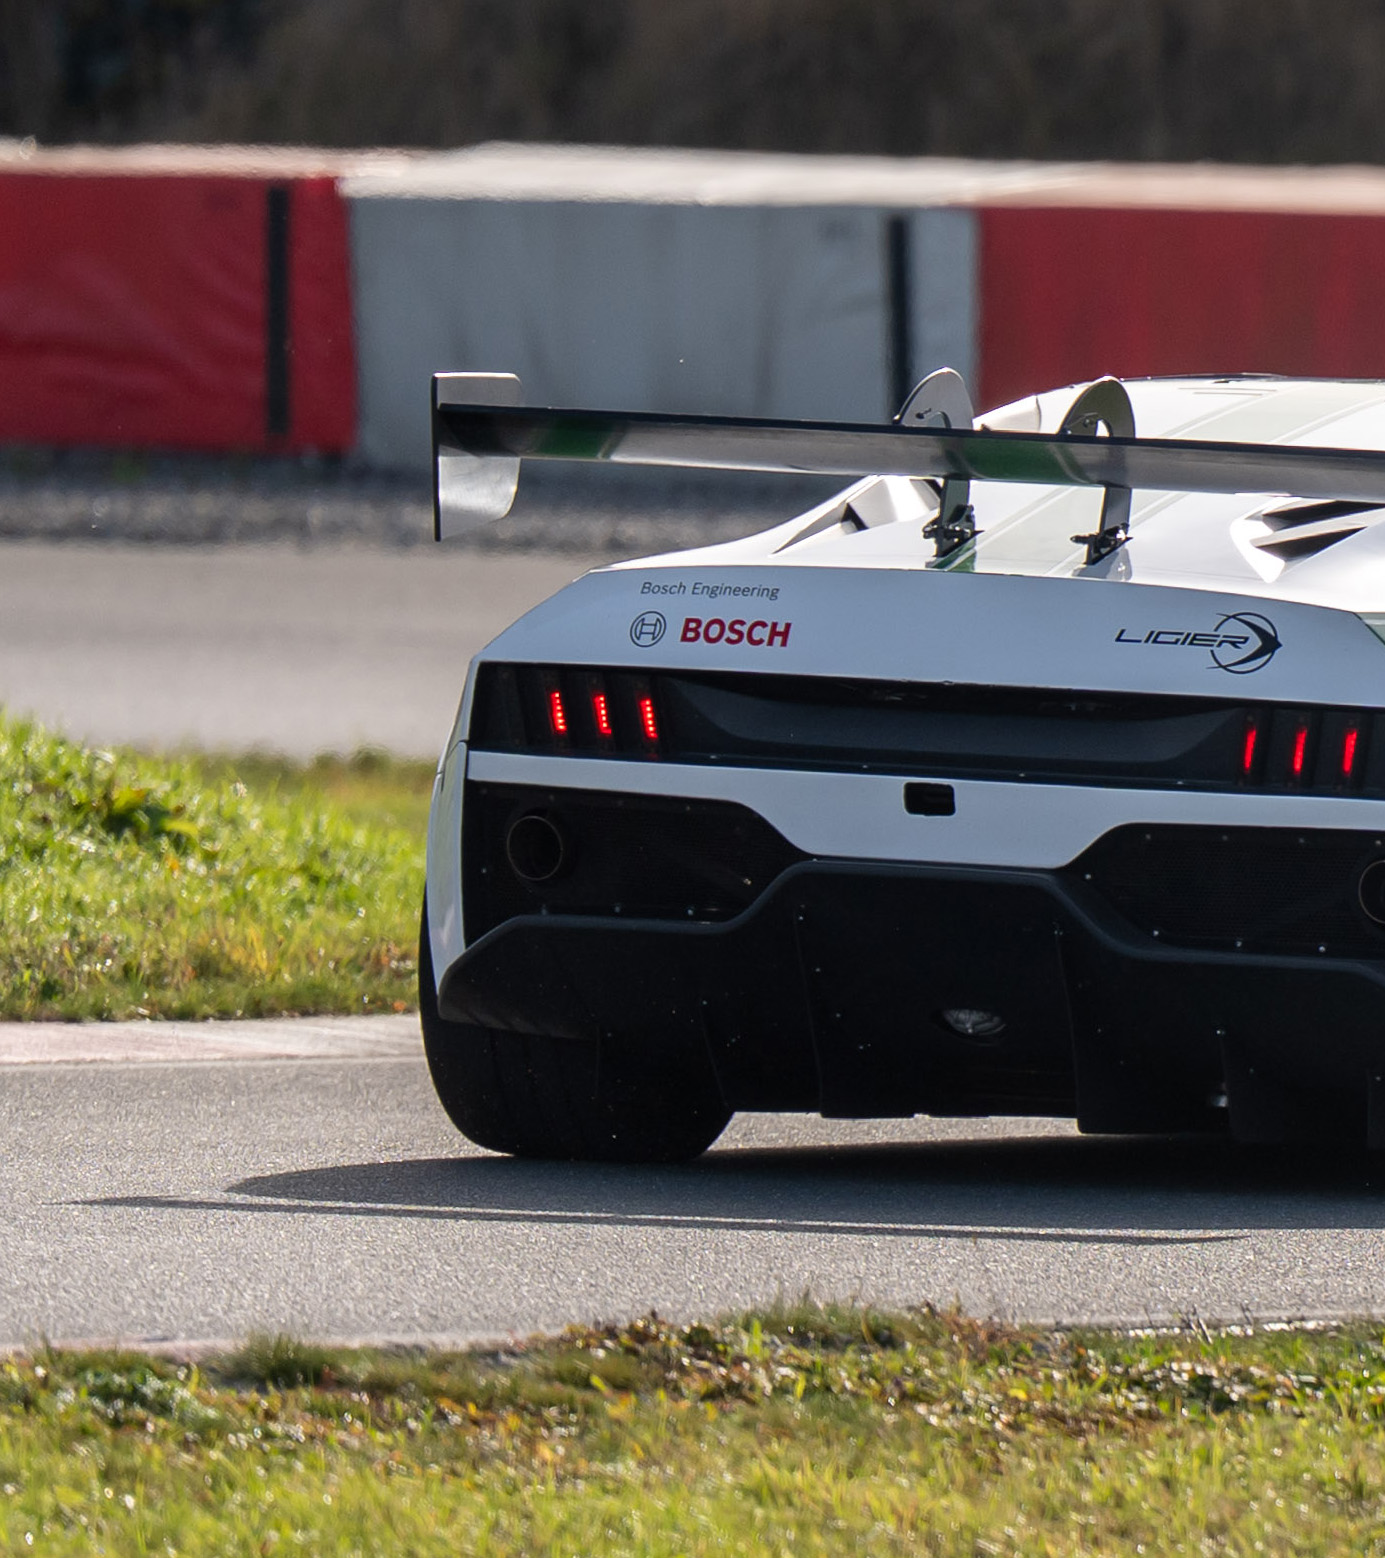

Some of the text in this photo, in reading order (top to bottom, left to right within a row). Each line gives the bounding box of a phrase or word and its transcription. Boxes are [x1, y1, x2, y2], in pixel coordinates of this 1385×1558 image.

[640, 581, 780, 601] Bosch Engineering
[680, 617, 792, 648] BOSCH
[1114, 628, 1250, 650] LIGIER
